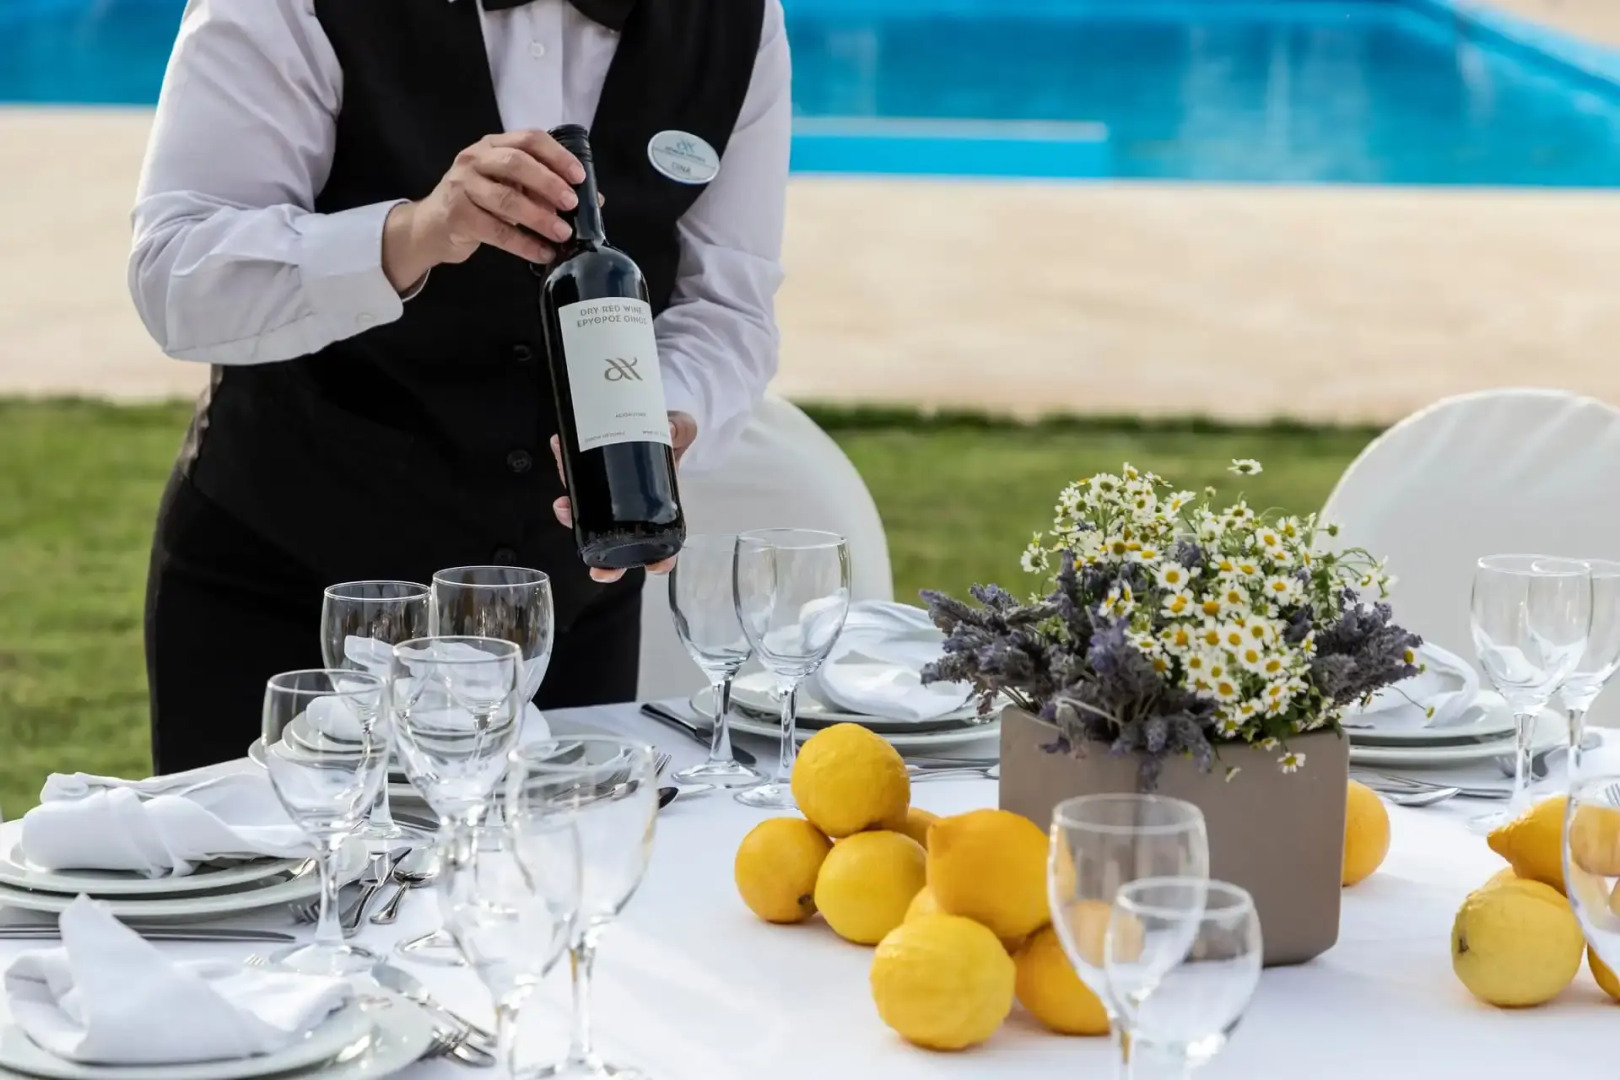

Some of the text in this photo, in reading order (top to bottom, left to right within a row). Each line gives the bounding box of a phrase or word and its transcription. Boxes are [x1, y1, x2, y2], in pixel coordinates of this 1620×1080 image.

[580, 304, 642, 316] DRY RED WINE
